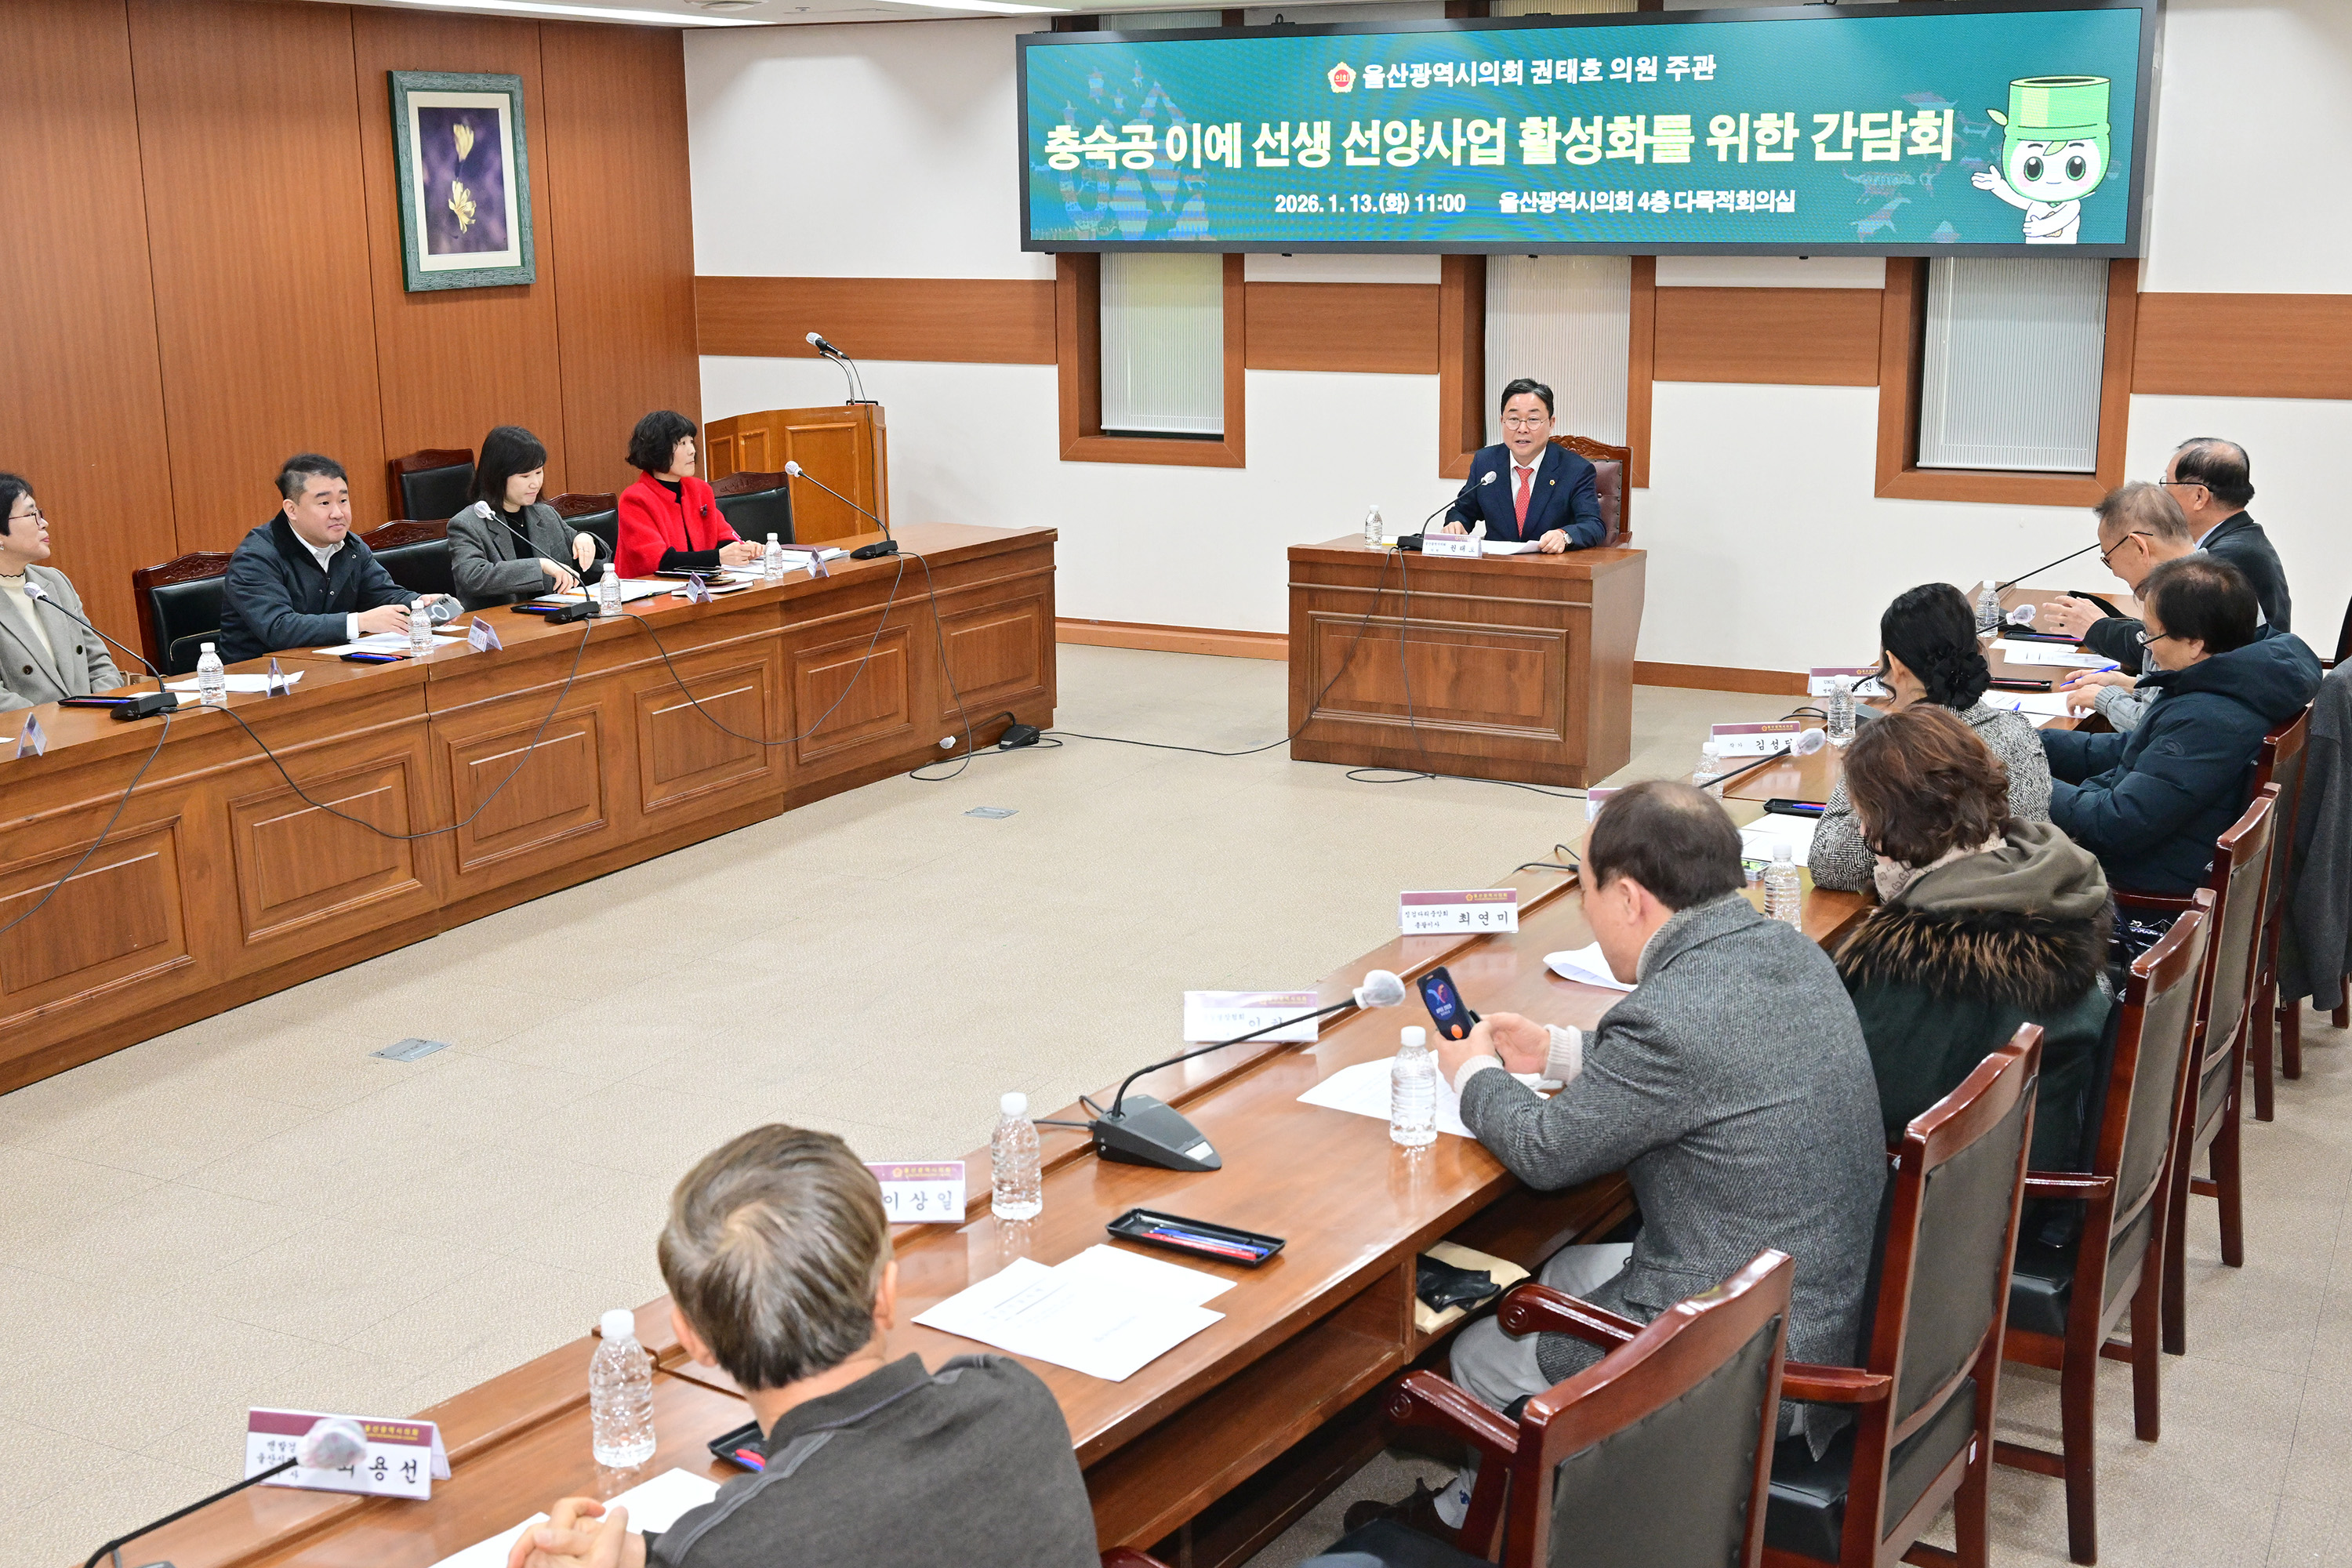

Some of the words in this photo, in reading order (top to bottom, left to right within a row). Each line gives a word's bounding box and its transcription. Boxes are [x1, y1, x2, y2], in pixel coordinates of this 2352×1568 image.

[1362, 60, 1523, 89] 울산광역시의회
[1530, 57, 1603, 85] 권태호
[1609, 56, 1658, 83] 의원
[1665, 54, 1717, 82] 주관
[1044, 124, 1158, 171] 충숙공
[1165, 122, 1242, 169] 이예
[1251, 120, 1331, 169] 선생
[1341, 117, 1507, 168] 선양사업
[1518, 114, 1695, 166] 활성화를
[1706, 111, 1800, 163] 위한
[1810, 108, 1955, 162] 간담회
[1275, 194, 1324, 213] 2026.
[1414, 193, 1466, 212] 11:00
[1498, 190, 1634, 214] 울산광역시의회
[1637, 190, 1671, 213] 4층
[1674, 189, 1796, 213] 다목적회의실
